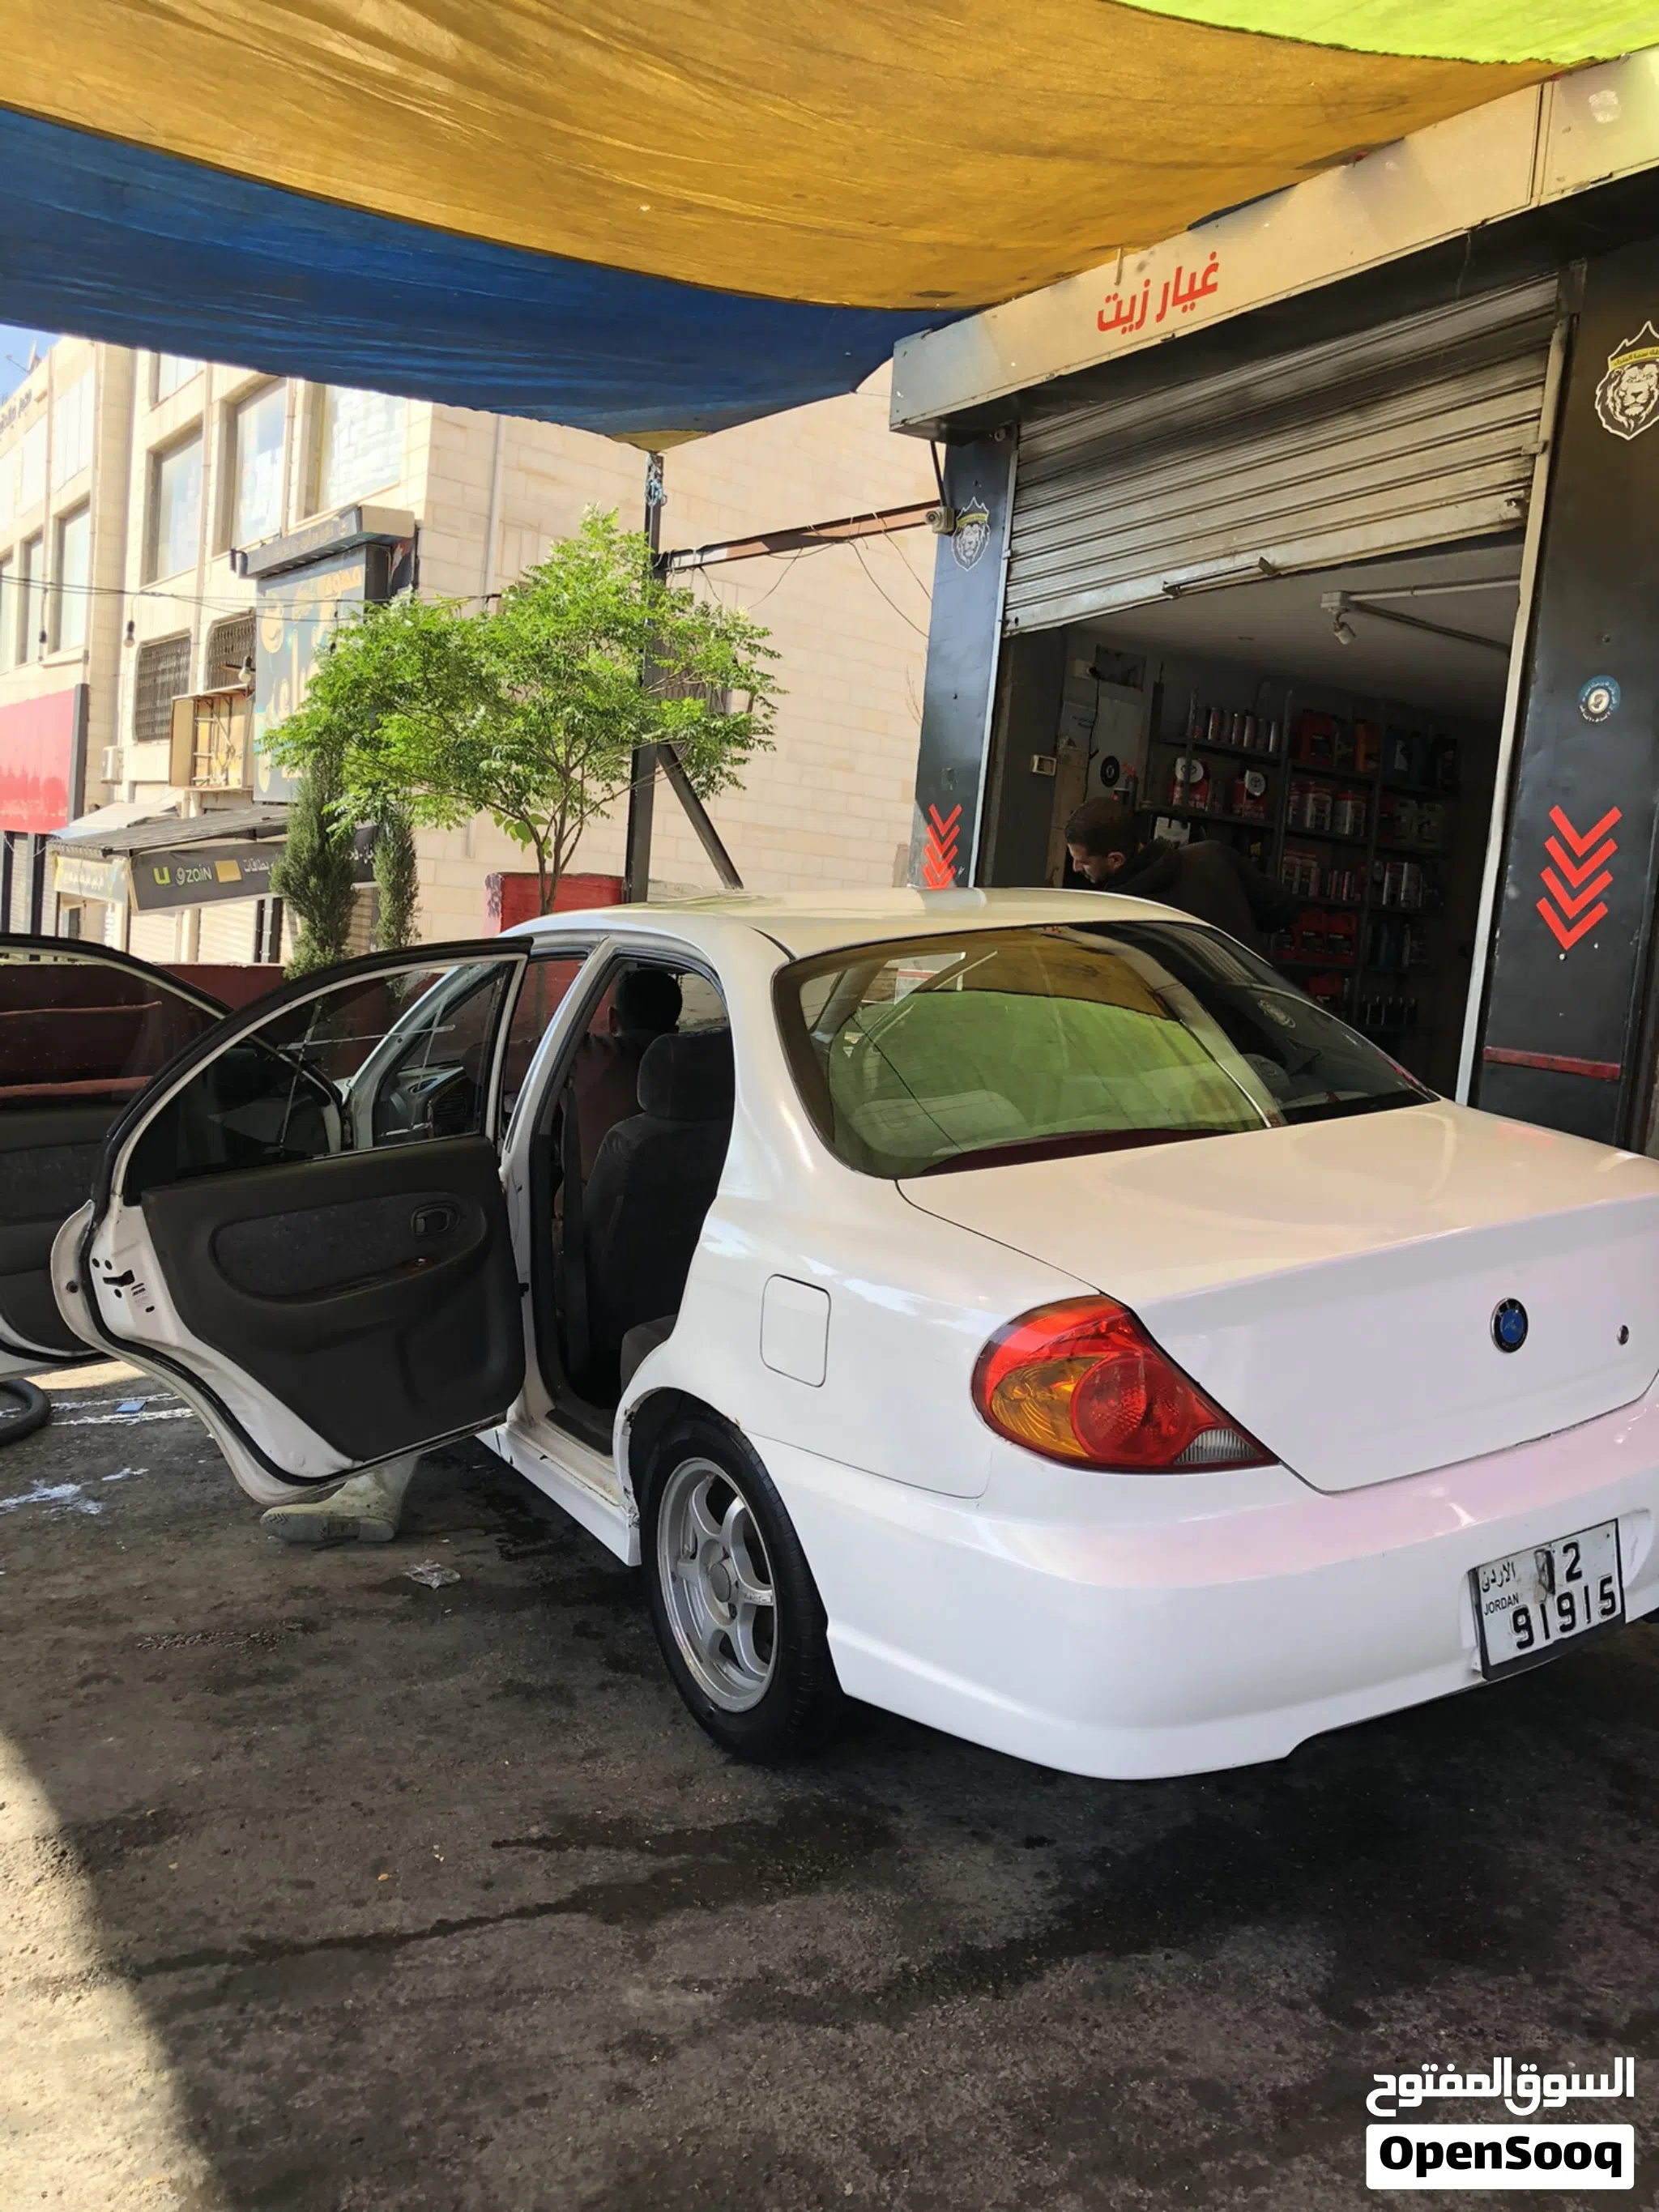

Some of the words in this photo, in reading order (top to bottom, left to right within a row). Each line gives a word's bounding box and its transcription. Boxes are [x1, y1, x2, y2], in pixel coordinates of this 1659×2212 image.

[1097, 278, 1151, 335] زيت
[1155, 250, 1220, 323] غيار
[1483, 1592, 1520, 1616] JORDAN
[1512, 1575, 1617, 1650] 91915
